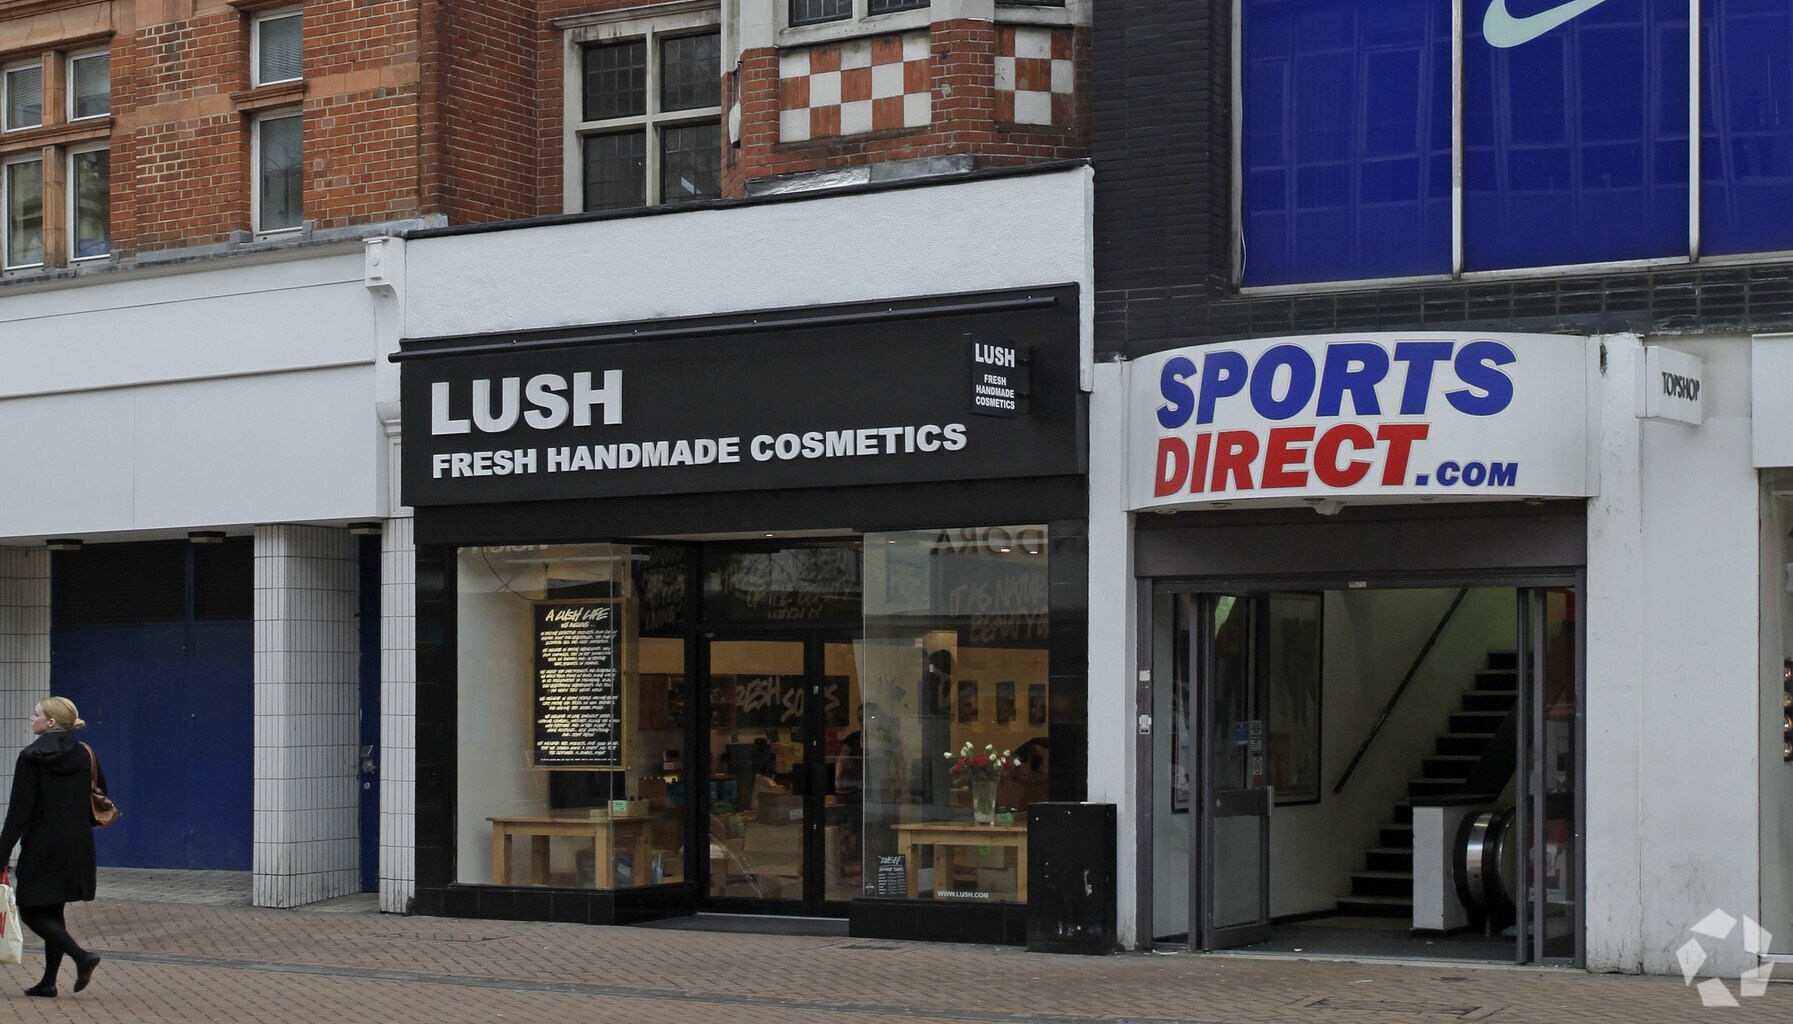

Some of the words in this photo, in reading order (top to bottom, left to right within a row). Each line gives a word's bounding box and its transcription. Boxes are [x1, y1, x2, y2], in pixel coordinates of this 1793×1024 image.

[975, 343, 1015, 368] LUSH
[984, 374, 1007, 386] FRESH
[1156, 341, 1517, 429] SPORTS
[1661, 371, 1700, 402] TOPSHOP
[975, 384, 1015, 398] HANDMADE
[431, 369, 623, 435] LUSH
[975, 396, 1016, 410] COSMETICS
[432, 448, 538, 479] FRESH
[547, 437, 741, 473] HANDMADE
[750, 423, 968, 461] COSMETICS
[545, 608, 555, 622] A
[555, 607, 584, 622] LUSH
[582, 607, 610, 621] LIFE
[937, 890, 989, 898] WWW.LUSH.COM
